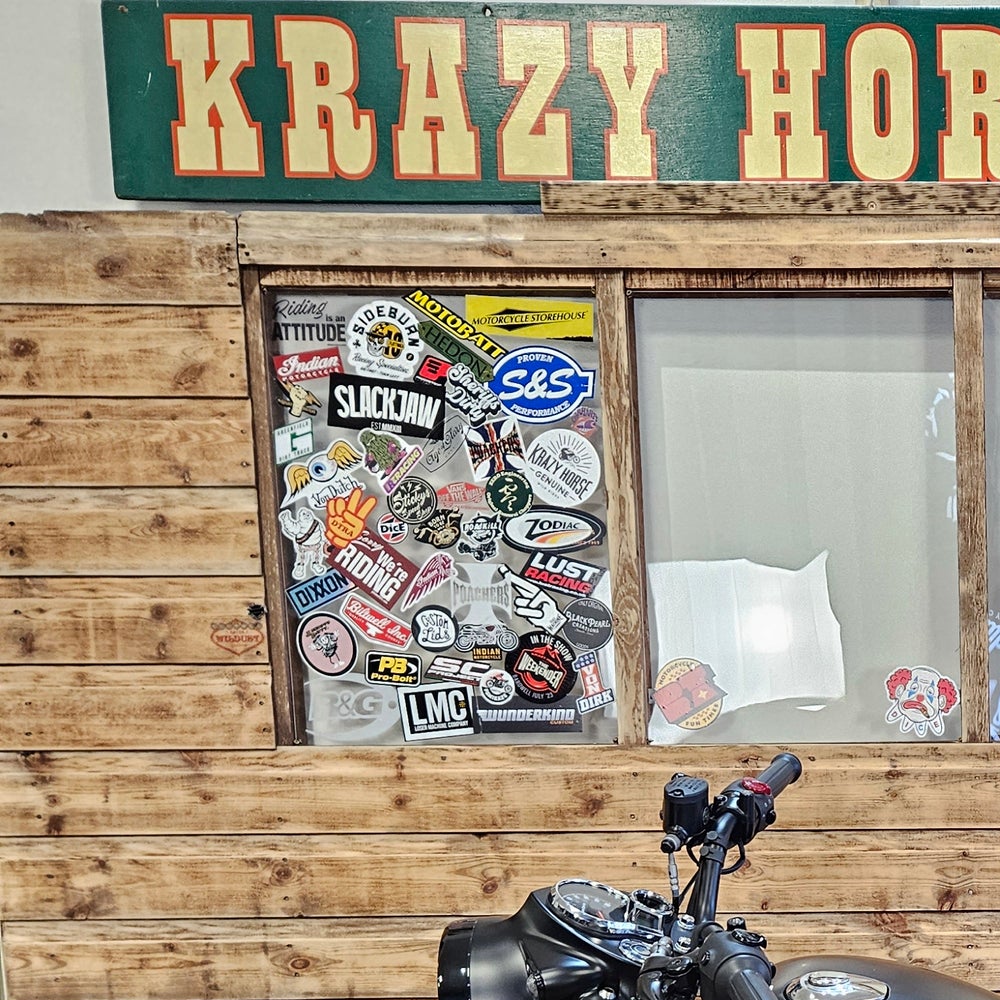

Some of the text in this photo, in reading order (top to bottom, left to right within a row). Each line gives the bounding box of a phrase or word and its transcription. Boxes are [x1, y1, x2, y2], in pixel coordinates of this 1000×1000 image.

[164, 14, 668, 181] KRAZY
[274, 299, 328, 319] Riding
[472, 311, 586, 325] MOTORCYCLE STOREHOUSE
[273, 323, 346, 341] ATTITUDE
[353, 306, 420, 347] SIDEBURN
[408, 290, 506, 358] MOTOBATT
[425, 325, 485, 378] HEDON
[517, 353, 554, 364] PROVEN
[278, 356, 339, 376] Indian
[500, 368, 575, 400] S&S
[334, 384, 442, 429] SLACKJAW
[447, 388, 485, 420] Dirty
[510, 400, 571, 417] PERFORMANCE
[528, 443, 562, 474] KRAZY
[559, 468, 593, 500] HORSE
[535, 471, 569, 497] GENUINE
[311, 477, 360, 508] Von Dutch
[525, 519, 579, 540] ZODIAC
[334, 543, 400, 604] RIDING
[377, 549, 408, 582] We're
[531, 552, 600, 580] LUST
[295, 573, 348, 608] DIXXON
[525, 567, 592, 593] RACING
[347, 600, 386, 629] Biltwell
[421, 614, 449, 629] CUSTOM
[589, 617, 610, 628] PEARL
[422, 629, 450, 643] Lids
[530, 635, 538, 644] IN
[540, 635, 554, 645] THE
[554, 641, 573, 661] SHOW
[379, 656, 408, 674] PB
[473, 648, 500, 656] INDIAN
[371, 673, 414, 683] Pro-Bolt
[429, 656, 489, 676] SC
[517, 652, 563, 689] WEEKENDER
[409, 690, 467, 725] LMC
[580, 691, 614, 711] DIRK
[477, 709, 575, 721] WUNDERKIND
